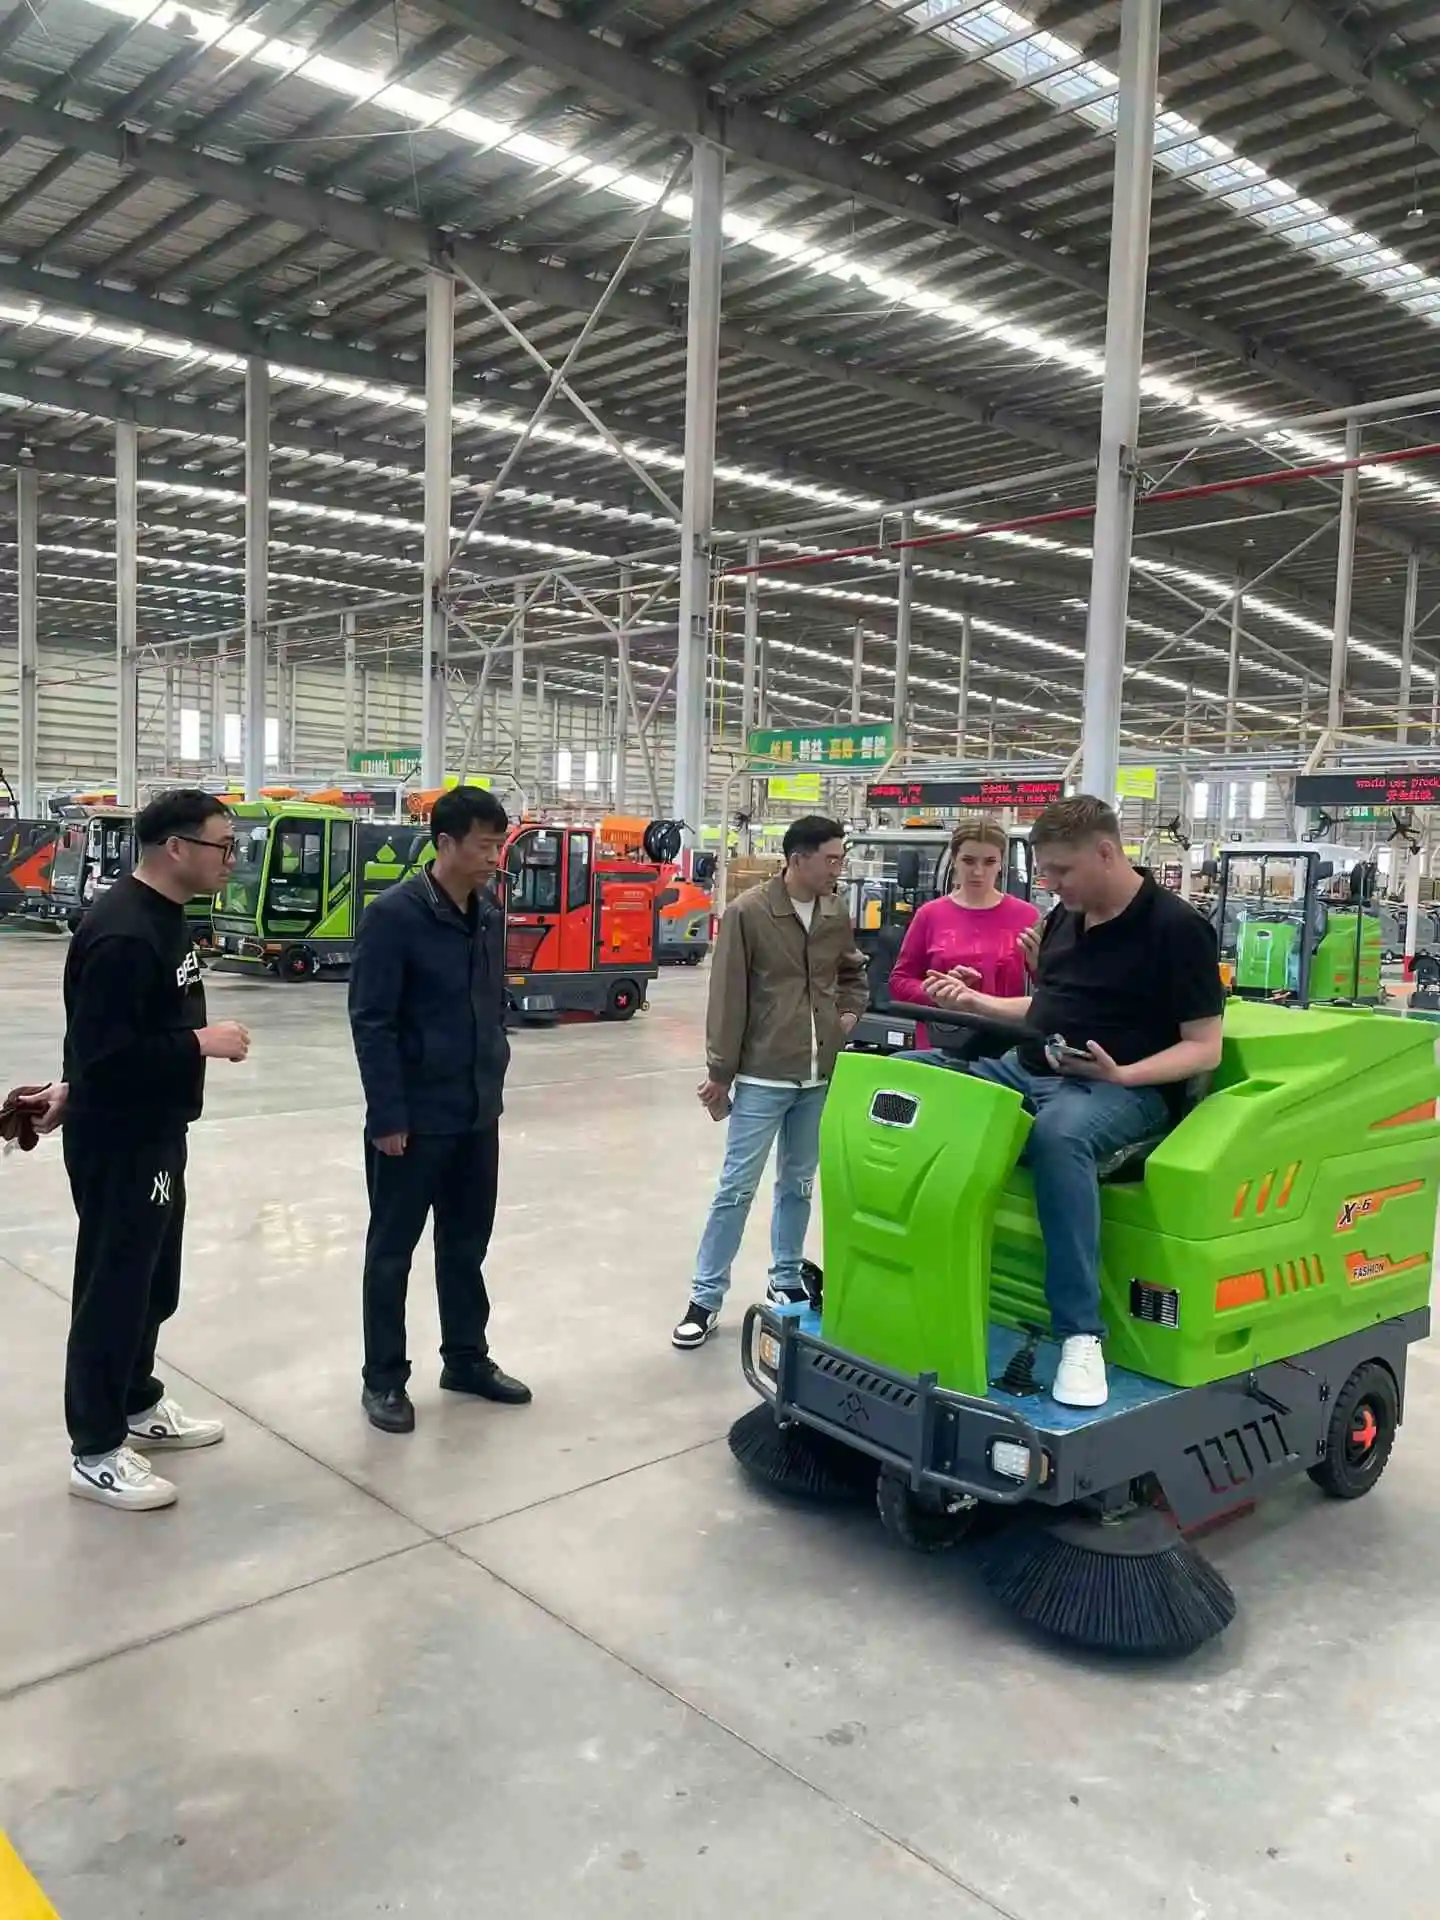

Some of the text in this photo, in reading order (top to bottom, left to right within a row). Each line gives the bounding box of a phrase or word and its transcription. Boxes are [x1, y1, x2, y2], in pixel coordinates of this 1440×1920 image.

[150, 1171, 171, 1204] NY
[1338, 1198, 1372, 1225] X-6
[1353, 1263, 1385, 1279] FASHION
